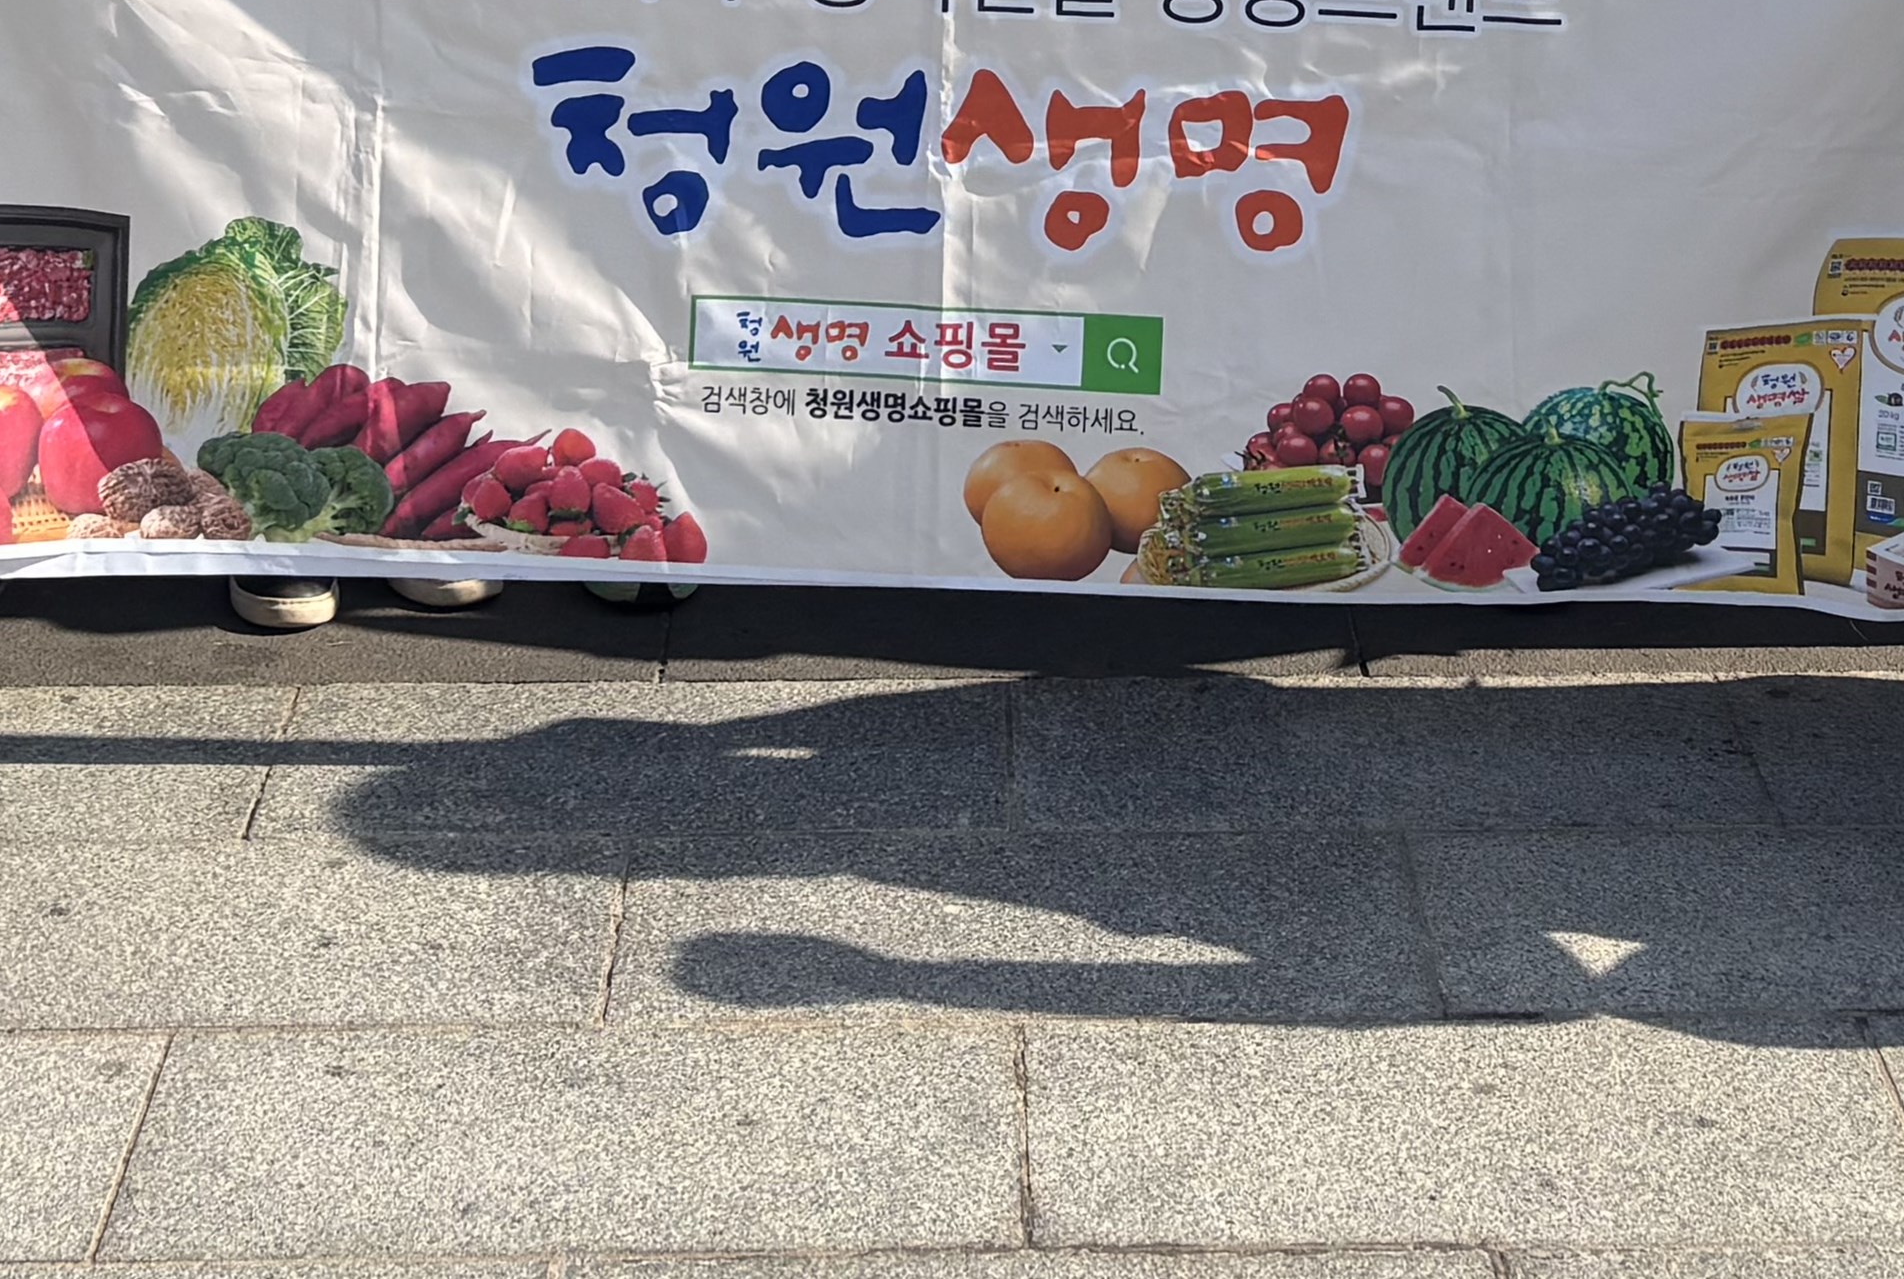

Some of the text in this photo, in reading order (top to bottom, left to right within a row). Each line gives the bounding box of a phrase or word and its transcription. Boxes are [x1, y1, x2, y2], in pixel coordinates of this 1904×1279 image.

[883, 320, 1027, 373] 쇼핑몰
[700, 384, 1145, 436] 검색창에 청원생명쇼핑몰을 검색하세요.
